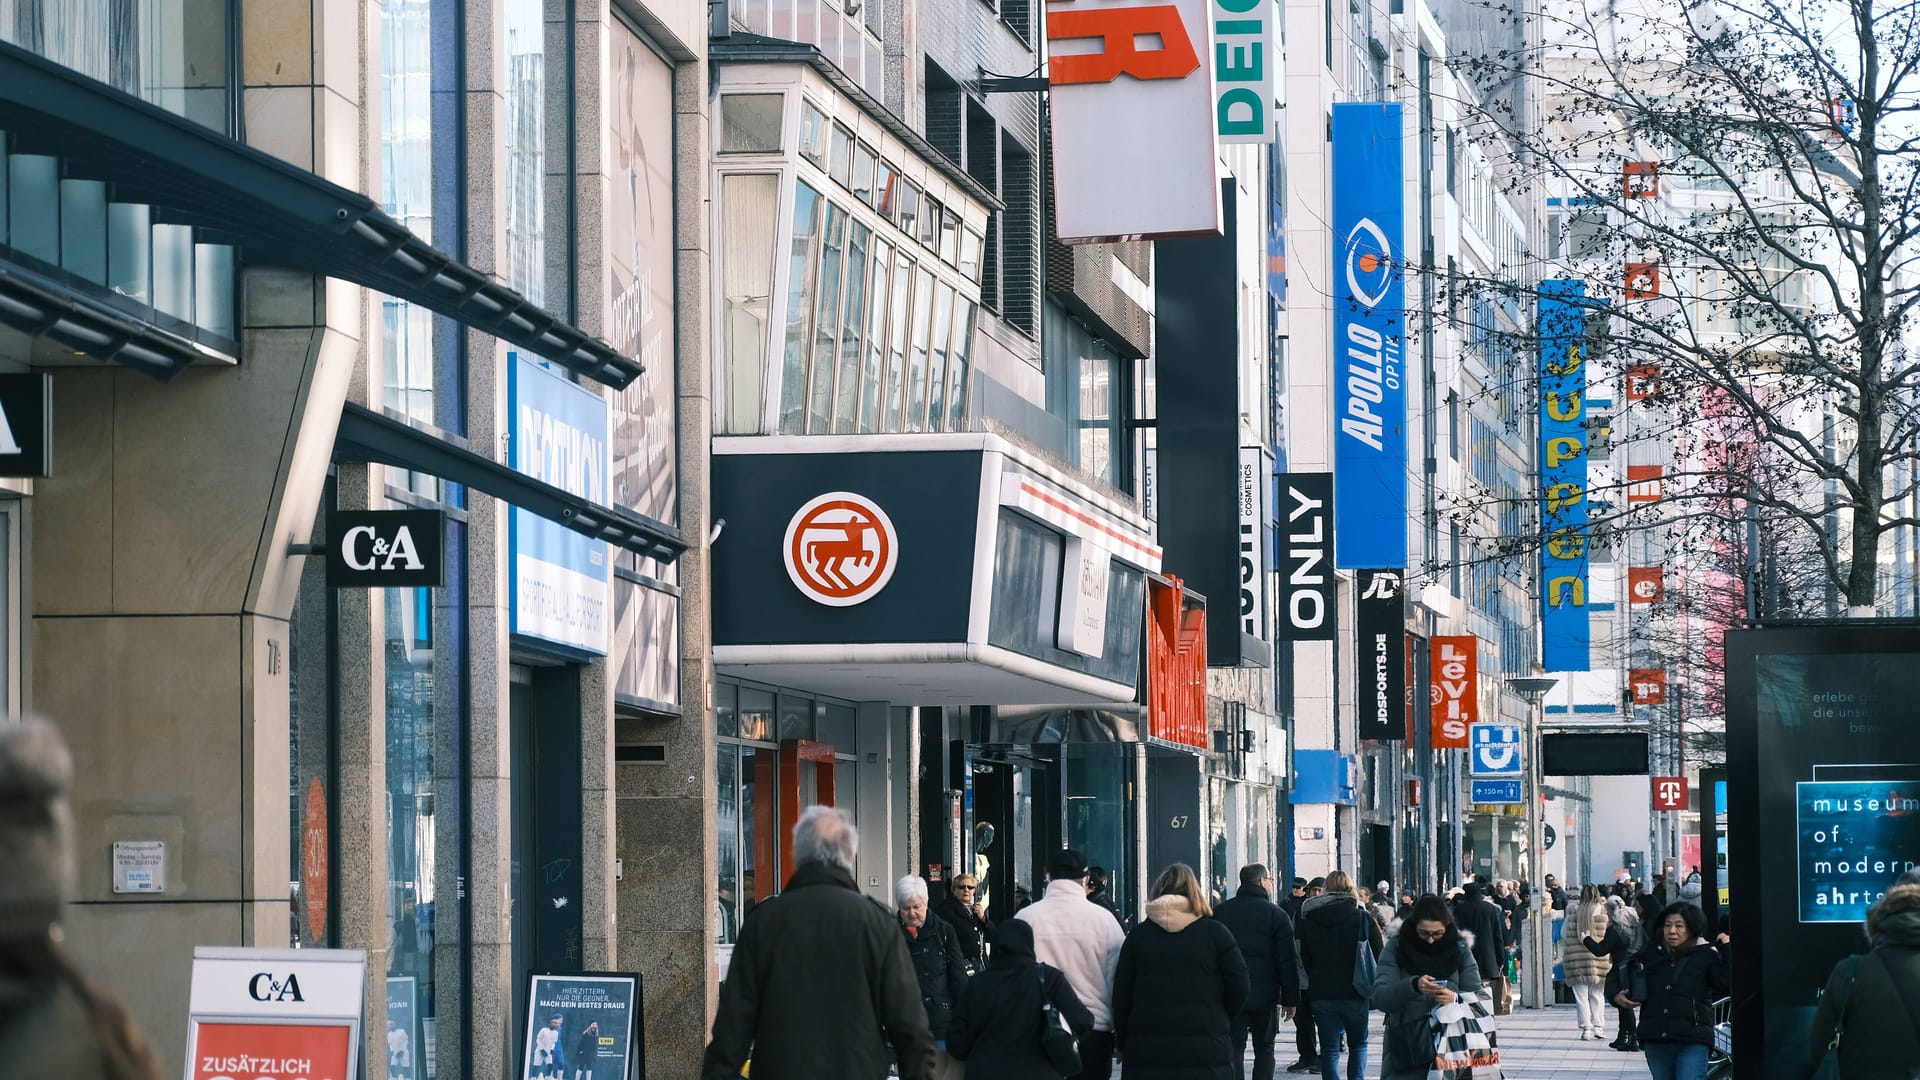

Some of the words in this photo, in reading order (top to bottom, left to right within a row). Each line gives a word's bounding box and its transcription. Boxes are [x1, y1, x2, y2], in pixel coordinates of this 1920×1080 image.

[1048, 0, 1200, 85] R
[1386, 335, 1399, 390] OPTIK
[1342, 322, 1383, 452] APOLLO
[1244, 463, 1253, 516] COSMETICS
[342, 525, 424, 571] C&A
[1289, 485, 1325, 629] ONLY
[1362, 572, 1400, 600] JD
[1376, 634, 1388, 725] JDSPORTS.DE
[1813, 691, 1854, 702] erlebe
[1813, 706, 1834, 718] die
[1480, 729, 1513, 769] U
[1660, 782, 1680, 806] T
[1814, 799, 1919, 811] museum
[1171, 815, 1188, 828] 67
[1814, 825, 1839, 843] of
[1815, 855, 1915, 873] modern
[249, 973, 305, 1002] C&A
[577, 1001, 602, 1009] BESTES
[203, 1055, 311, 1074] ZUSÄTZLICH
